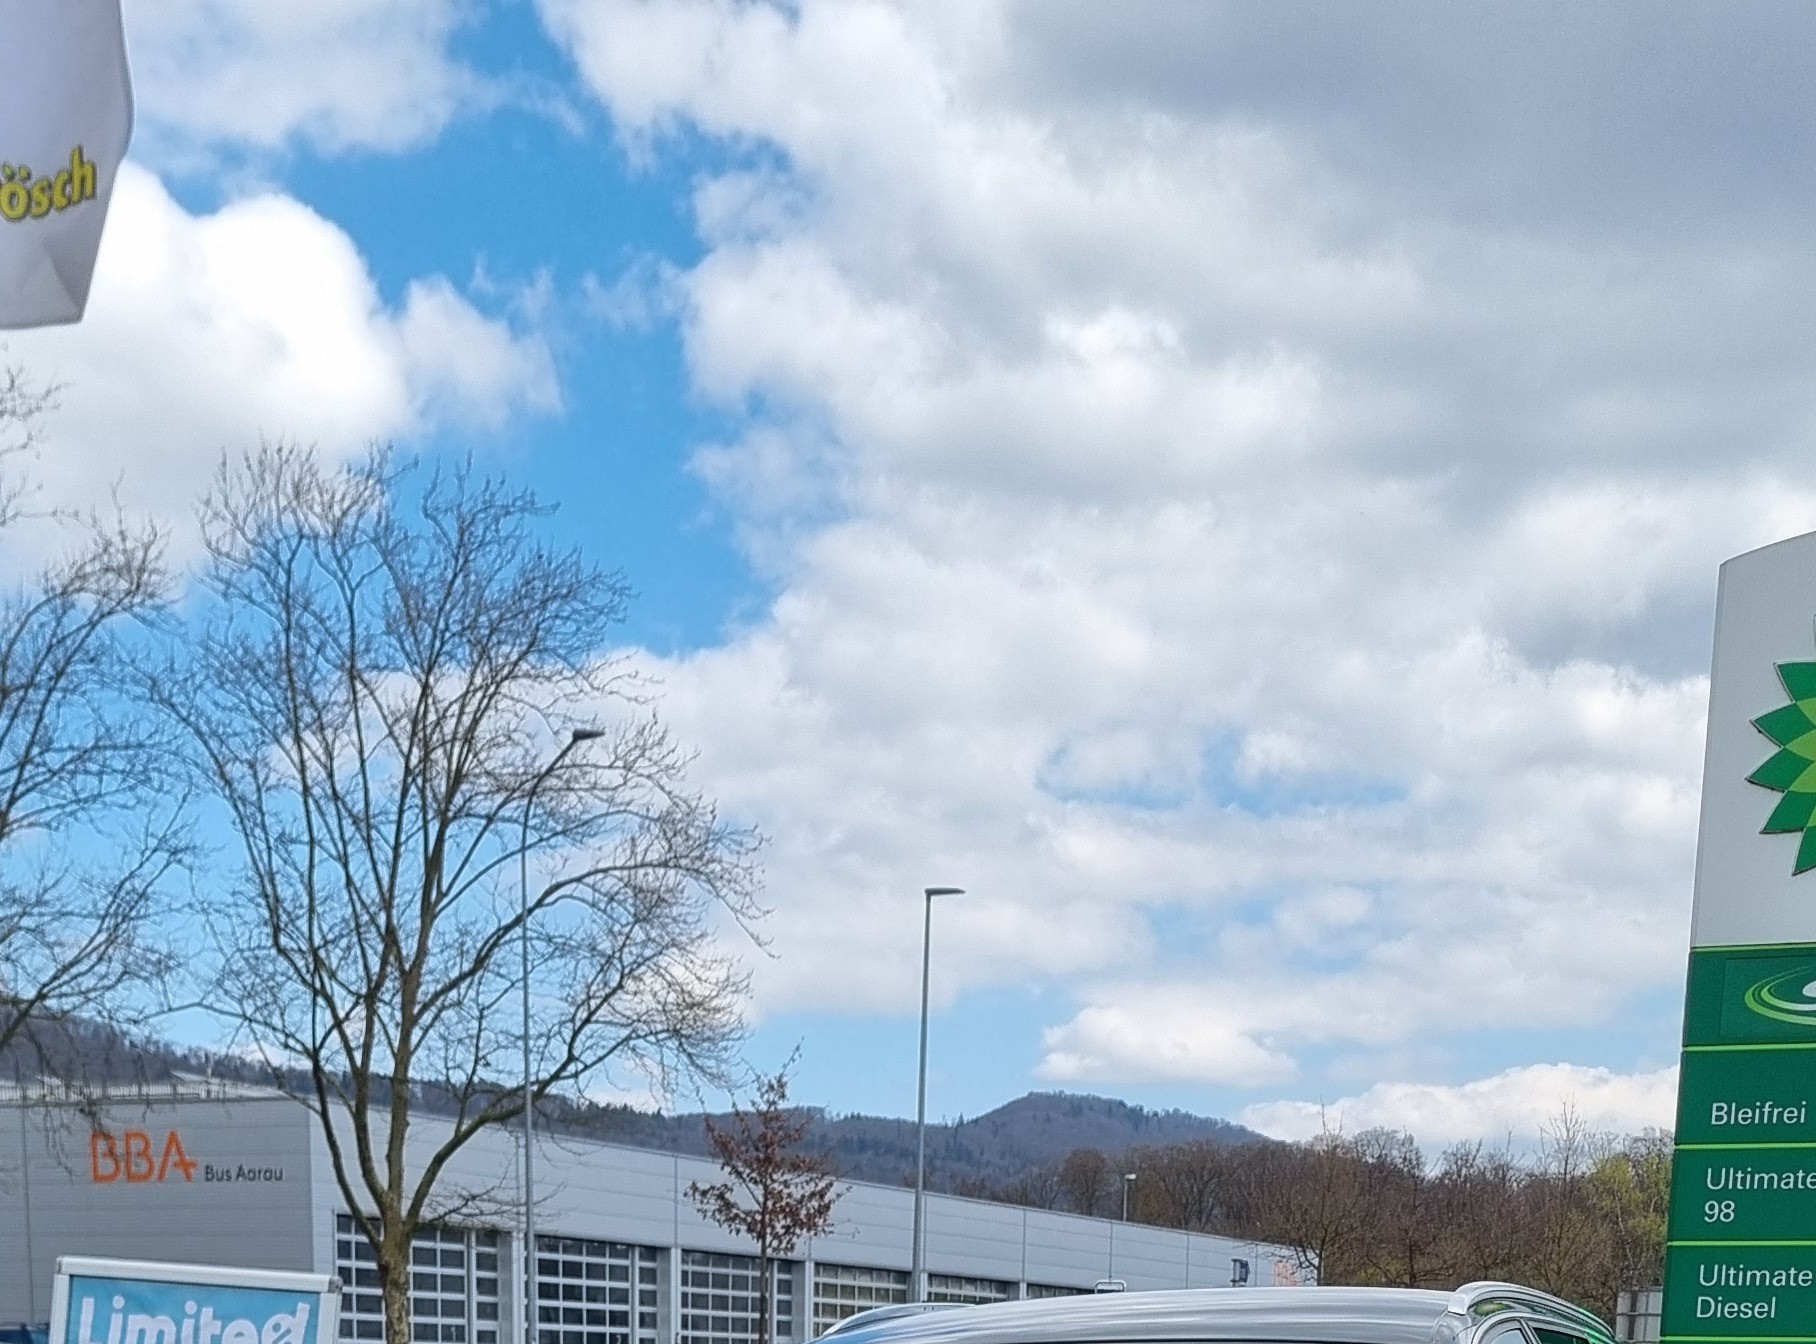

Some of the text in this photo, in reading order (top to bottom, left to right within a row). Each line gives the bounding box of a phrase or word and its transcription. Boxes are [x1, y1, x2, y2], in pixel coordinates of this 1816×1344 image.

[0, 145, 97, 221] ösch
[1710, 1100, 1807, 1125] Bleifrei
[90, 1130, 198, 1183] BBA
[205, 1164, 284, 1182] Bus Aarau
[1706, 1167, 1816, 1190] Ultimate
[1704, 1200, 1735, 1222] 98
[1699, 1263, 1813, 1287] Ultimate
[1696, 1296, 1776, 1319] Diesel
